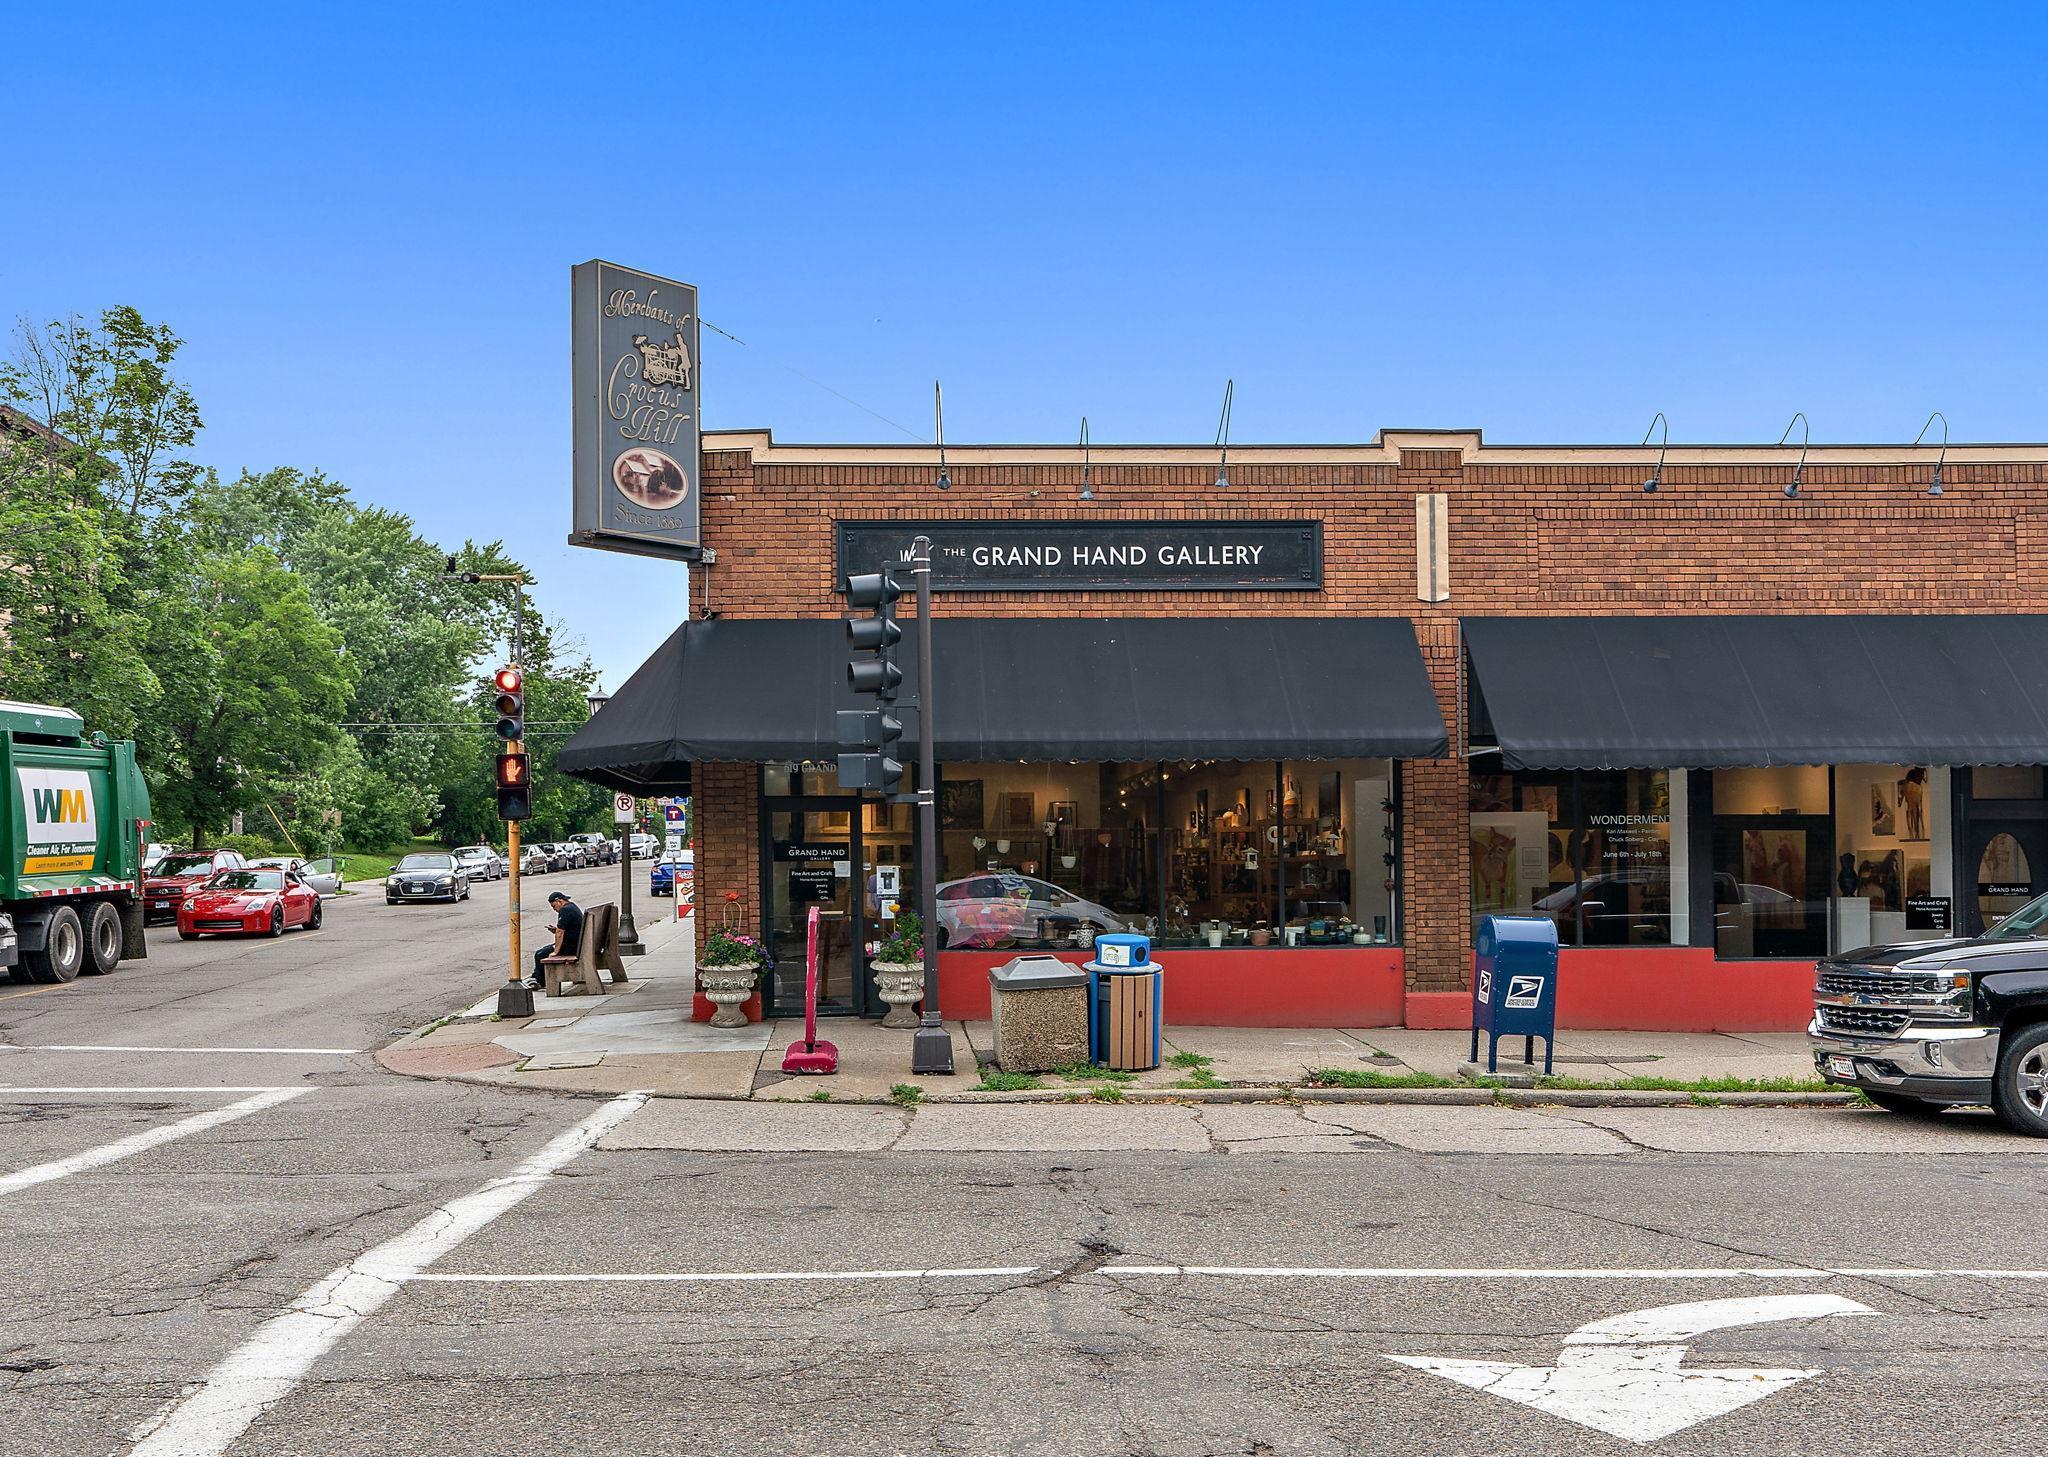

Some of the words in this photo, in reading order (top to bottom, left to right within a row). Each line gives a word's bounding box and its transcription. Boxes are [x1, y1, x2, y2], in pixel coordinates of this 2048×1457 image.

[604, 289, 674, 325] Merchants
[675, 313, 691, 332] of
[607, 353, 682, 420] Crocus
[620, 405, 691, 444] Hill
[615, 502, 654, 525] Since
[657, 514, 683, 529] 1880
[944, 548, 967, 557] THE
[972, 546, 1062, 566] GRAND
[1073, 546, 1147, 566] HAND
[1158, 545, 1264, 565] GALLERY
[801, 763, 837, 773] GRAND
[33, 788, 87, 823] WM
[27, 845, 50, 856] Cleaner
[50, 844, 61, 855] Air,
[61, 844, 71, 854] For
[72, 843, 96, 853] Tomorrow
[788, 849, 819, 857] GRAND
